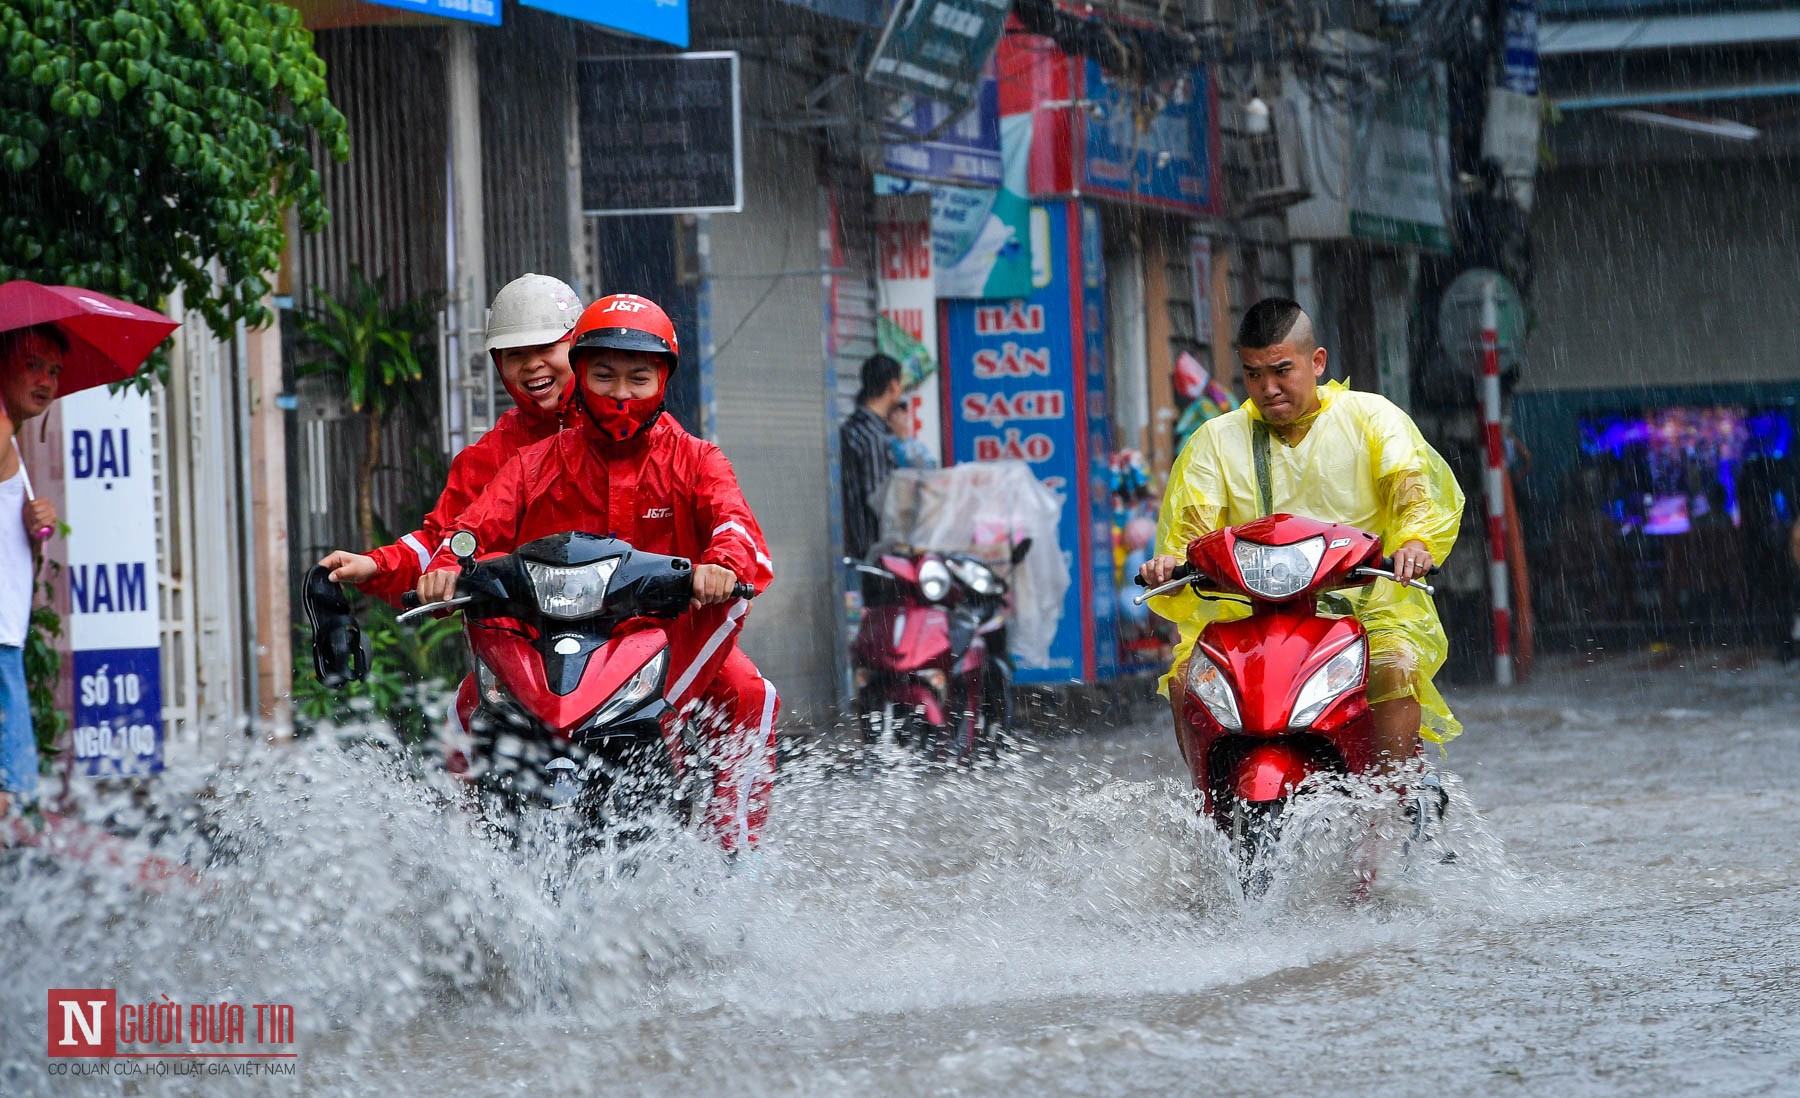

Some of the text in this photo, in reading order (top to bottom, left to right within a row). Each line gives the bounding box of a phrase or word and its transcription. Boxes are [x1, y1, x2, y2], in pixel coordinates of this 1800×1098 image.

[603, 300, 648, 313] J&T
[975, 299, 1044, 335] HẢI
[972, 341, 1050, 379] SẢN
[962, 389, 1065, 428] SẠCH
[72, 427, 130, 490] ĐẠI
[973, 427, 1054, 463] BẢO
[70, 563, 147, 613] NAM
[81, 663, 140, 707] SỐ 10
